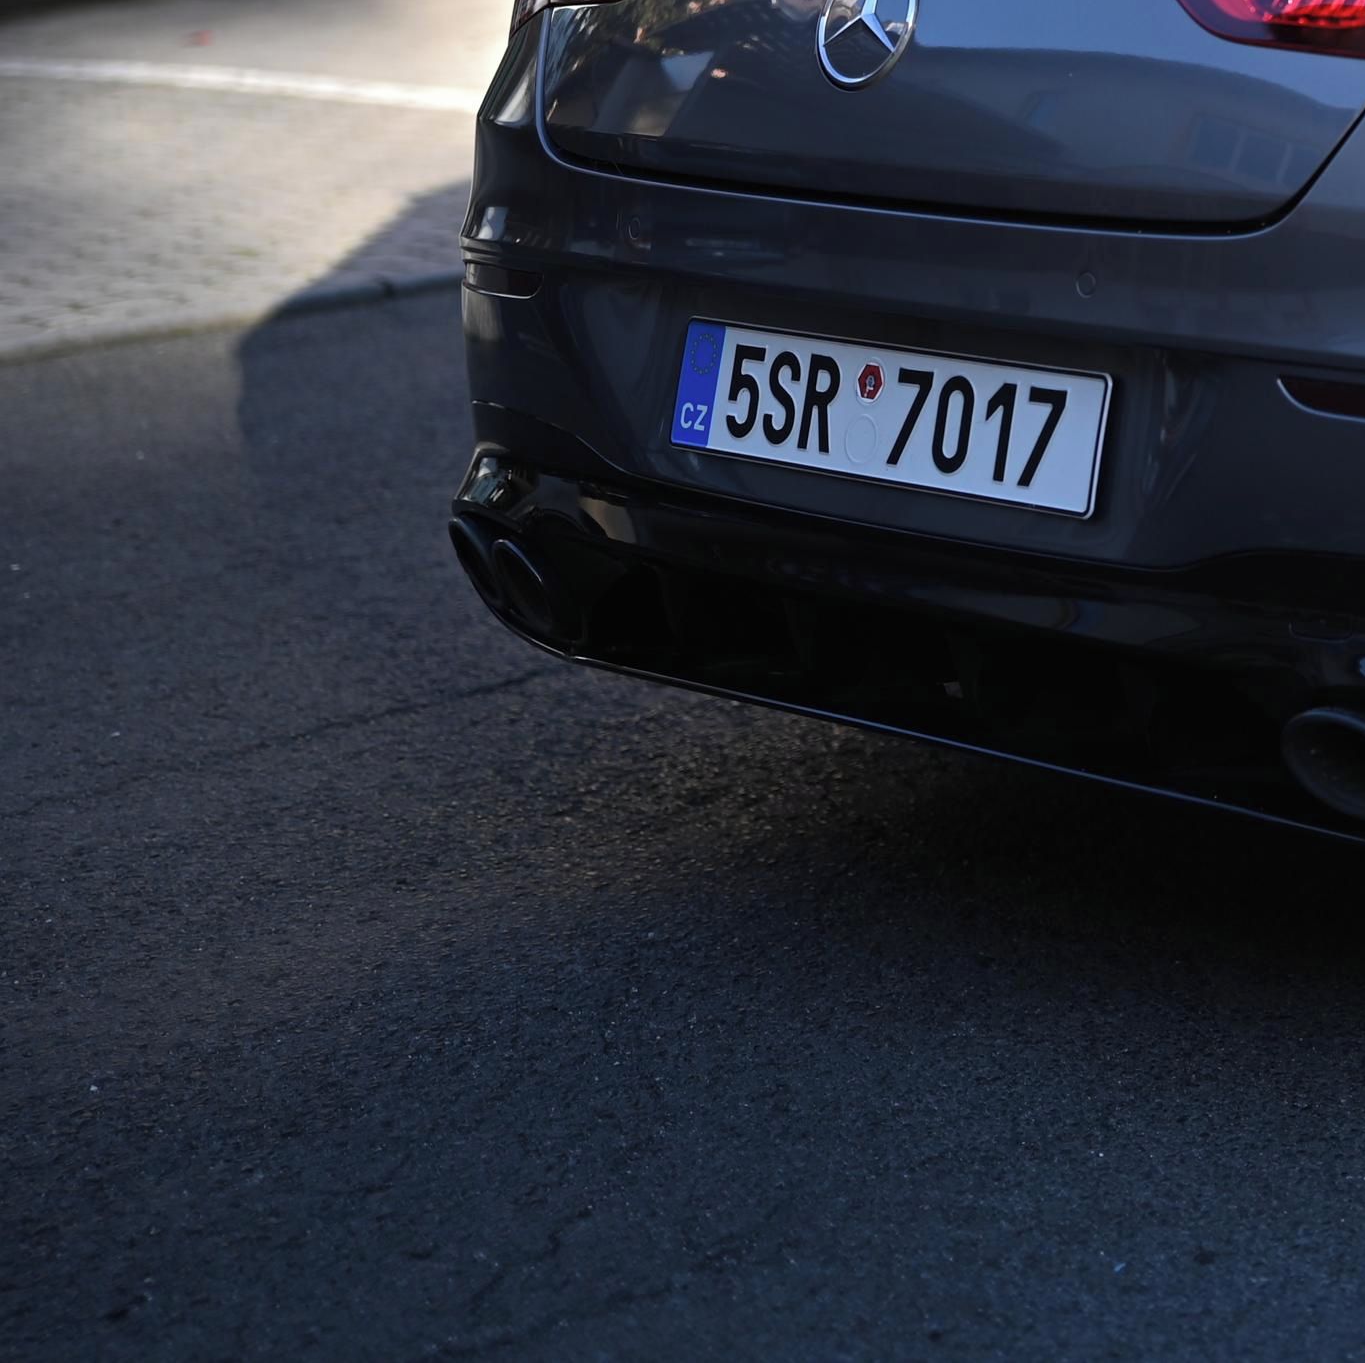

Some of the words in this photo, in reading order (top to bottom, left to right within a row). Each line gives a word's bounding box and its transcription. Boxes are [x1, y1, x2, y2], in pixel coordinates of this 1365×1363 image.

[680, 402, 708, 431] CZ
[726, 344, 841, 454] 5SR
[886, 367, 1068, 487] 7017
